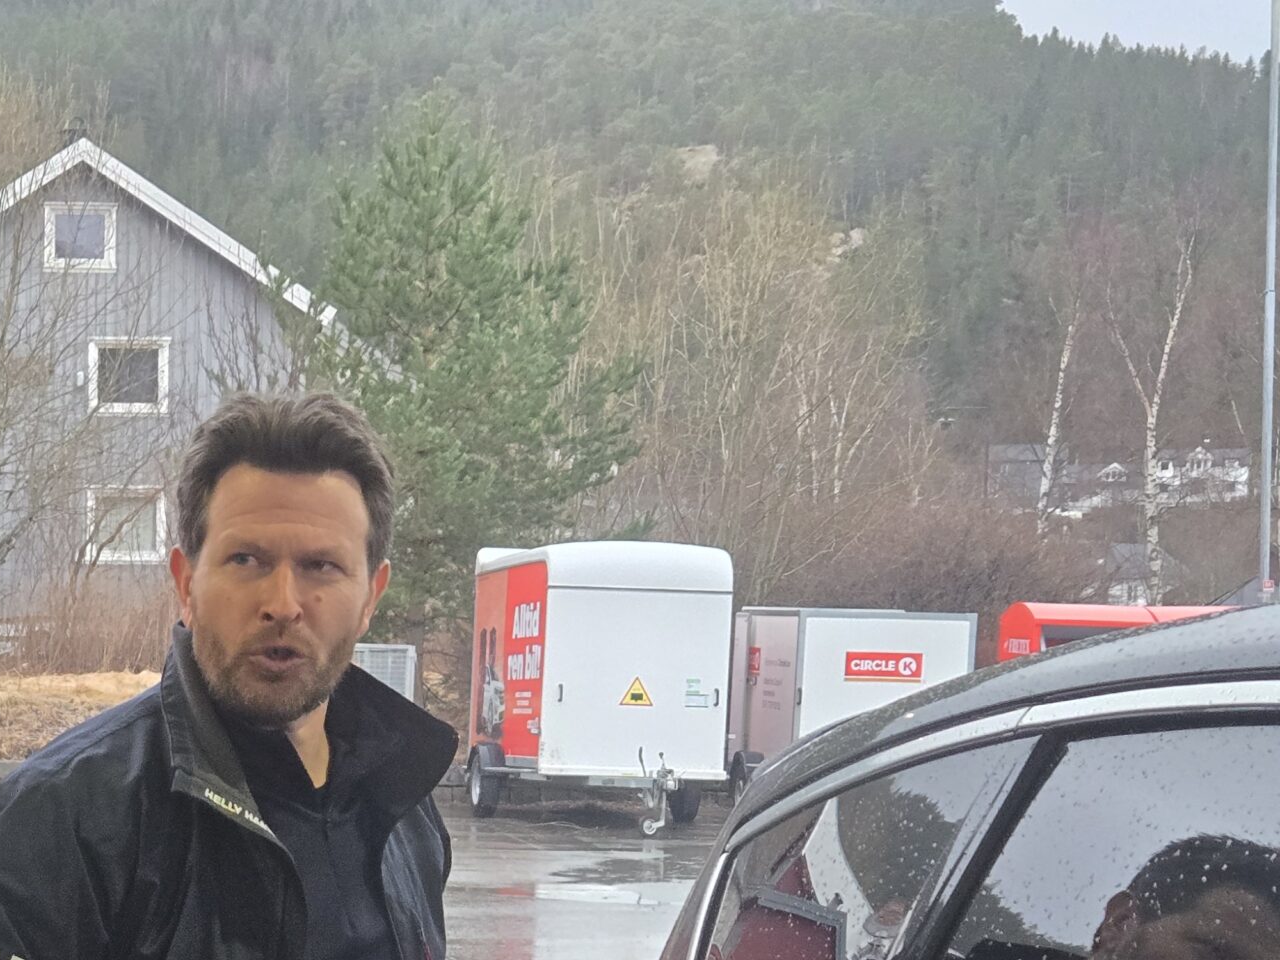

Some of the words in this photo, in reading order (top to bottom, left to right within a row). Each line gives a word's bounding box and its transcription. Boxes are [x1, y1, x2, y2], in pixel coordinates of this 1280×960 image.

[512, 601, 541, 639] Alltid
[507, 653, 523, 680] ren
[850, 659, 896, 672] CIRCLE
[898, 656, 917, 676] K
[204, 787, 243, 815] HELLY
